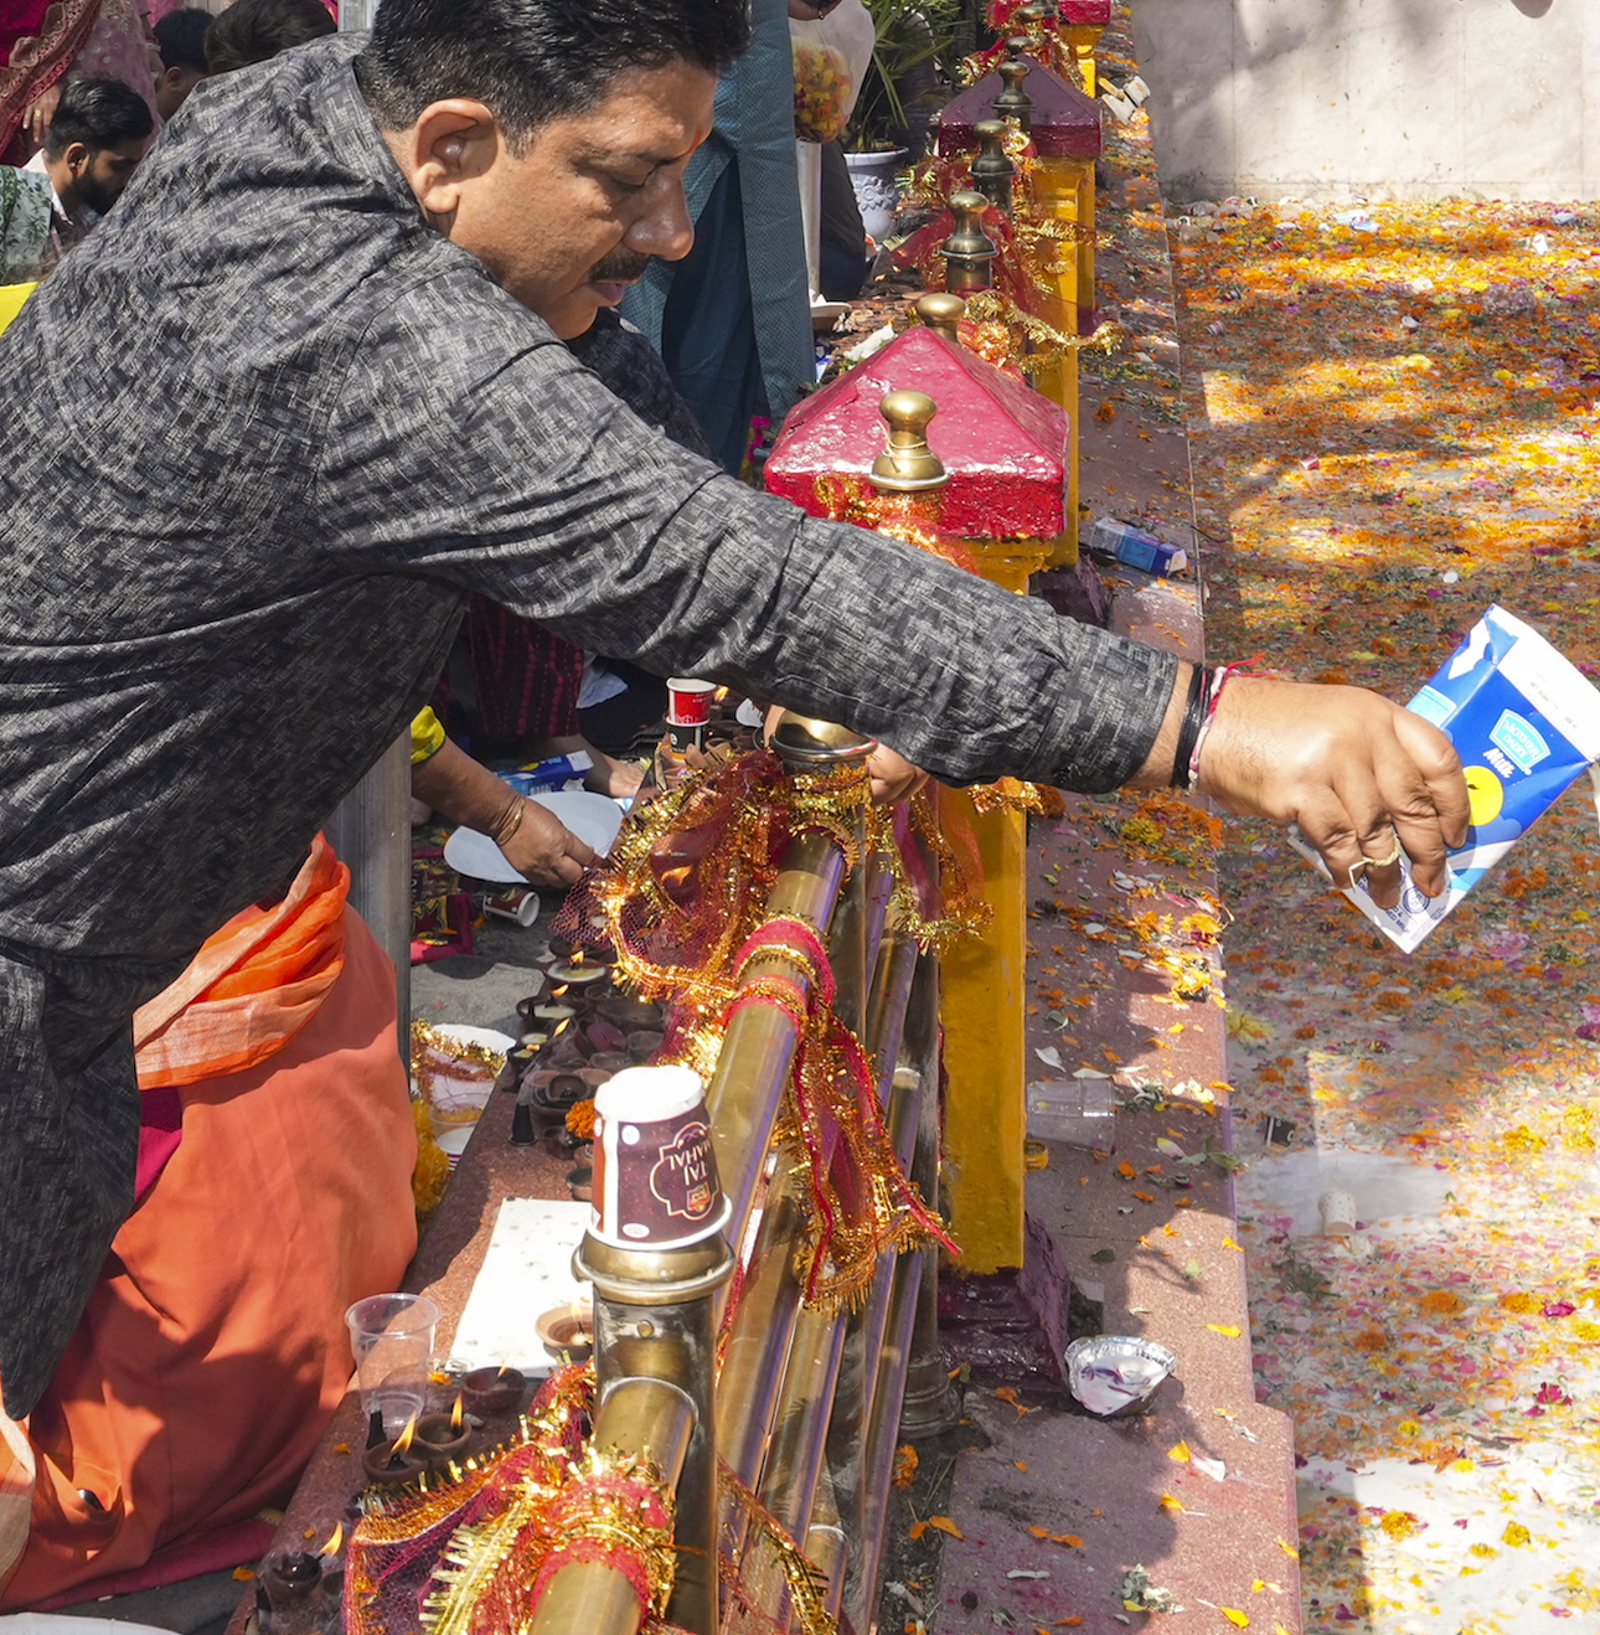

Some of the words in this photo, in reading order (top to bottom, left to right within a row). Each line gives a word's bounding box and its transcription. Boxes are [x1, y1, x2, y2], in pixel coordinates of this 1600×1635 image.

[1503, 733, 1530, 759] DAIRY
[1504, 720, 1541, 758] MOTHER
[1482, 747, 1516, 778] Milk
[669, 1139, 712, 1171] MAHAL
[684, 1160, 708, 1186] TAJ
